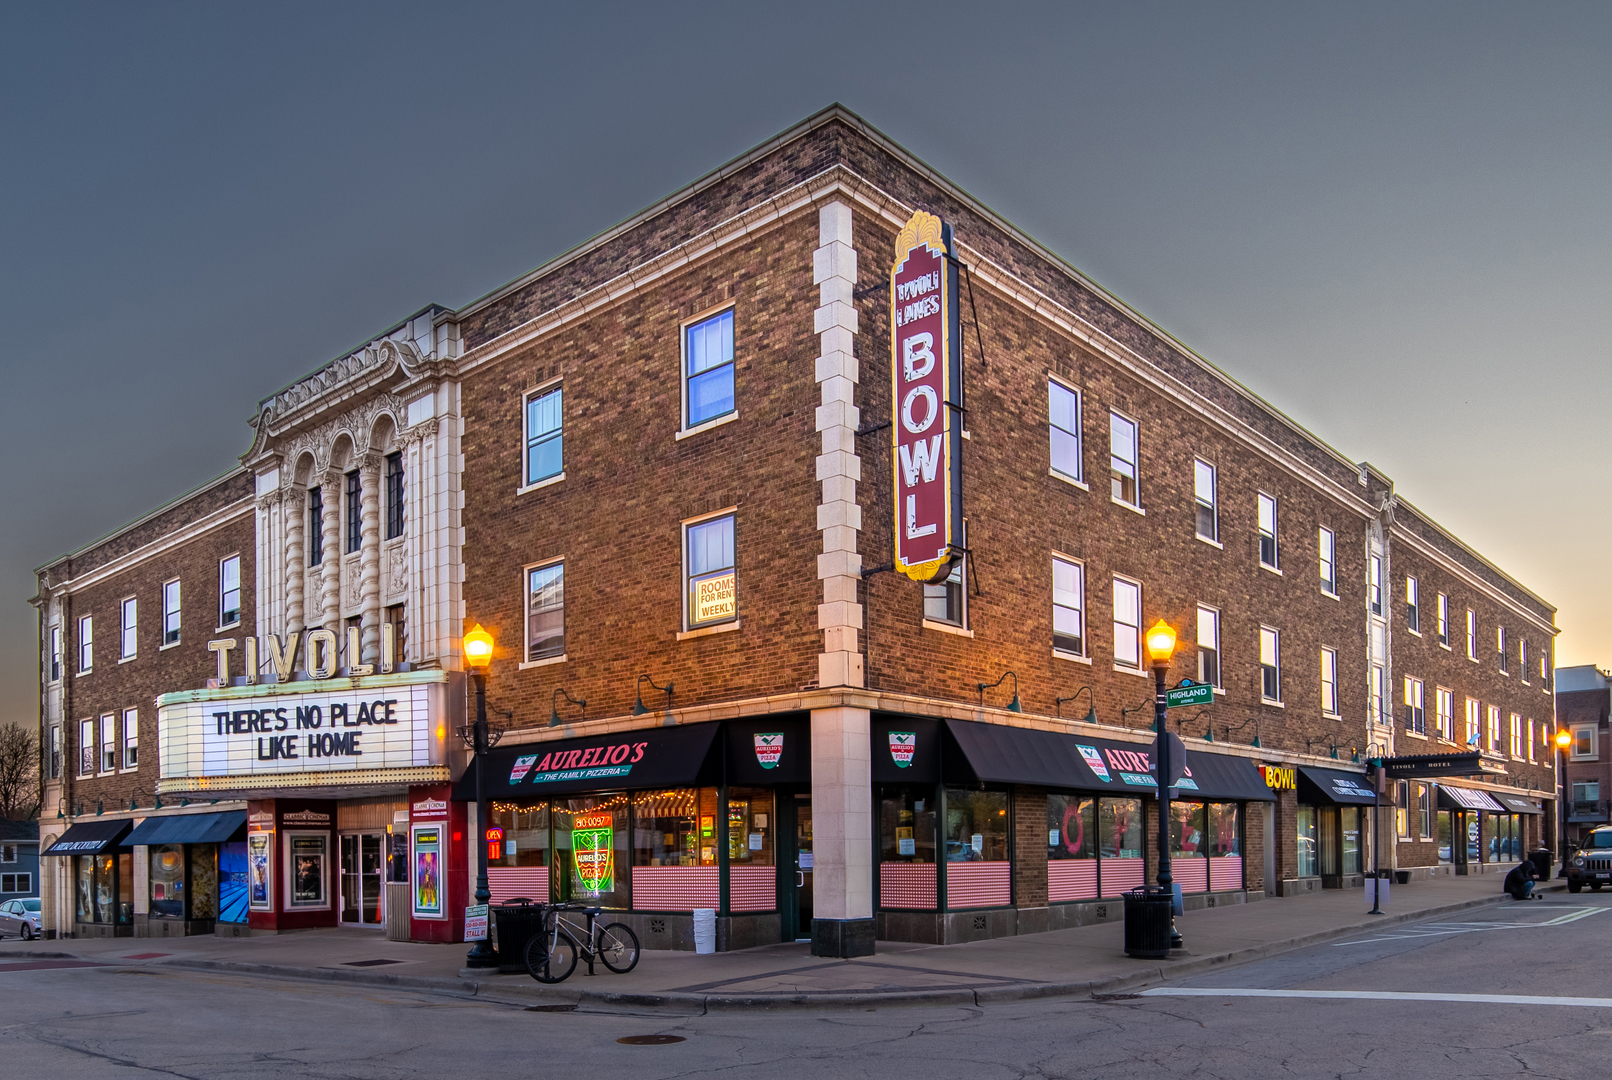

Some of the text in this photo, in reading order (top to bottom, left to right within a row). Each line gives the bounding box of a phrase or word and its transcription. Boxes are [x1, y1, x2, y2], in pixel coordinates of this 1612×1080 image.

[896, 270, 939, 303] TIVOLI
[896, 295, 940, 327] LANES
[899, 331, 942, 540] BOWL
[701, 577, 736, 595] ROOMS
[701, 593, 716, 603] FOR
[701, 601, 736, 617] WEEKLY
[207, 622, 394, 688] TIVOLI
[1170, 688, 1208, 700] HIGHLAND
[212, 699, 398, 735] THERE'S NO PLACE
[258, 731, 362, 761] LIKE HOME
[535, 742, 648, 771] AURELIO'S
[543, 767, 620, 781] THE FAMILY PIZZERIA
[1265, 765, 1297, 790] BOWL
[486, 830, 501, 840] OPEN
[466, 929, 480, 938] STALL
